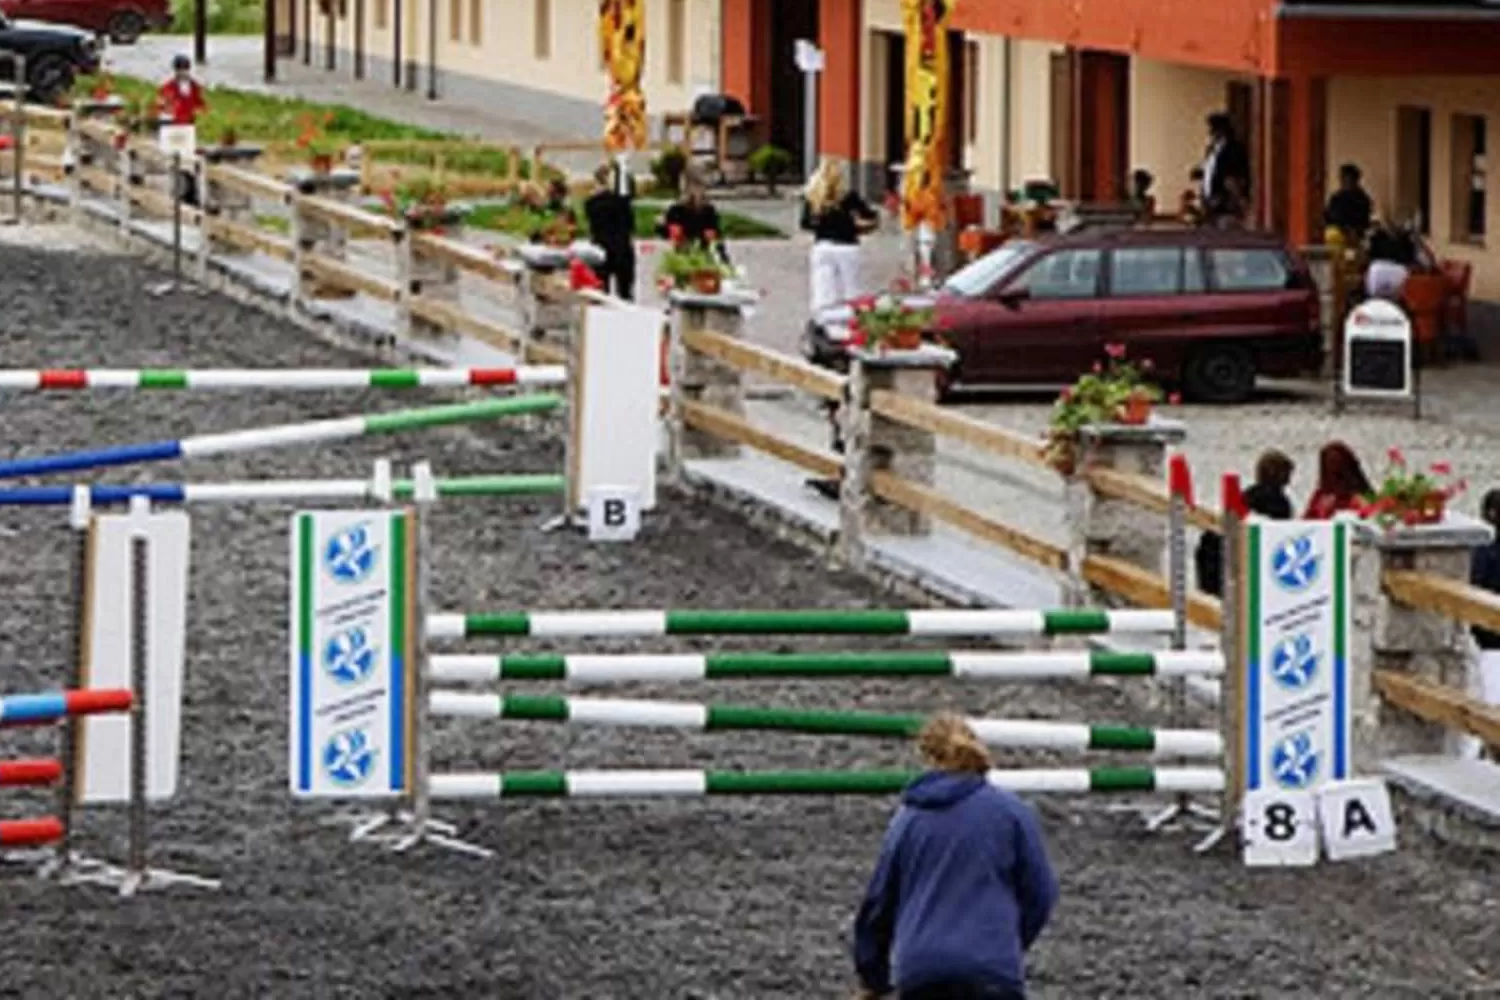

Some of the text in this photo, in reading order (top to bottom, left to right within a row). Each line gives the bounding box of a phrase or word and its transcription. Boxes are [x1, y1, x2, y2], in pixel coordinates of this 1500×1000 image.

[603, 498, 627, 527] B
[1264, 798, 1377, 841] 8 A
